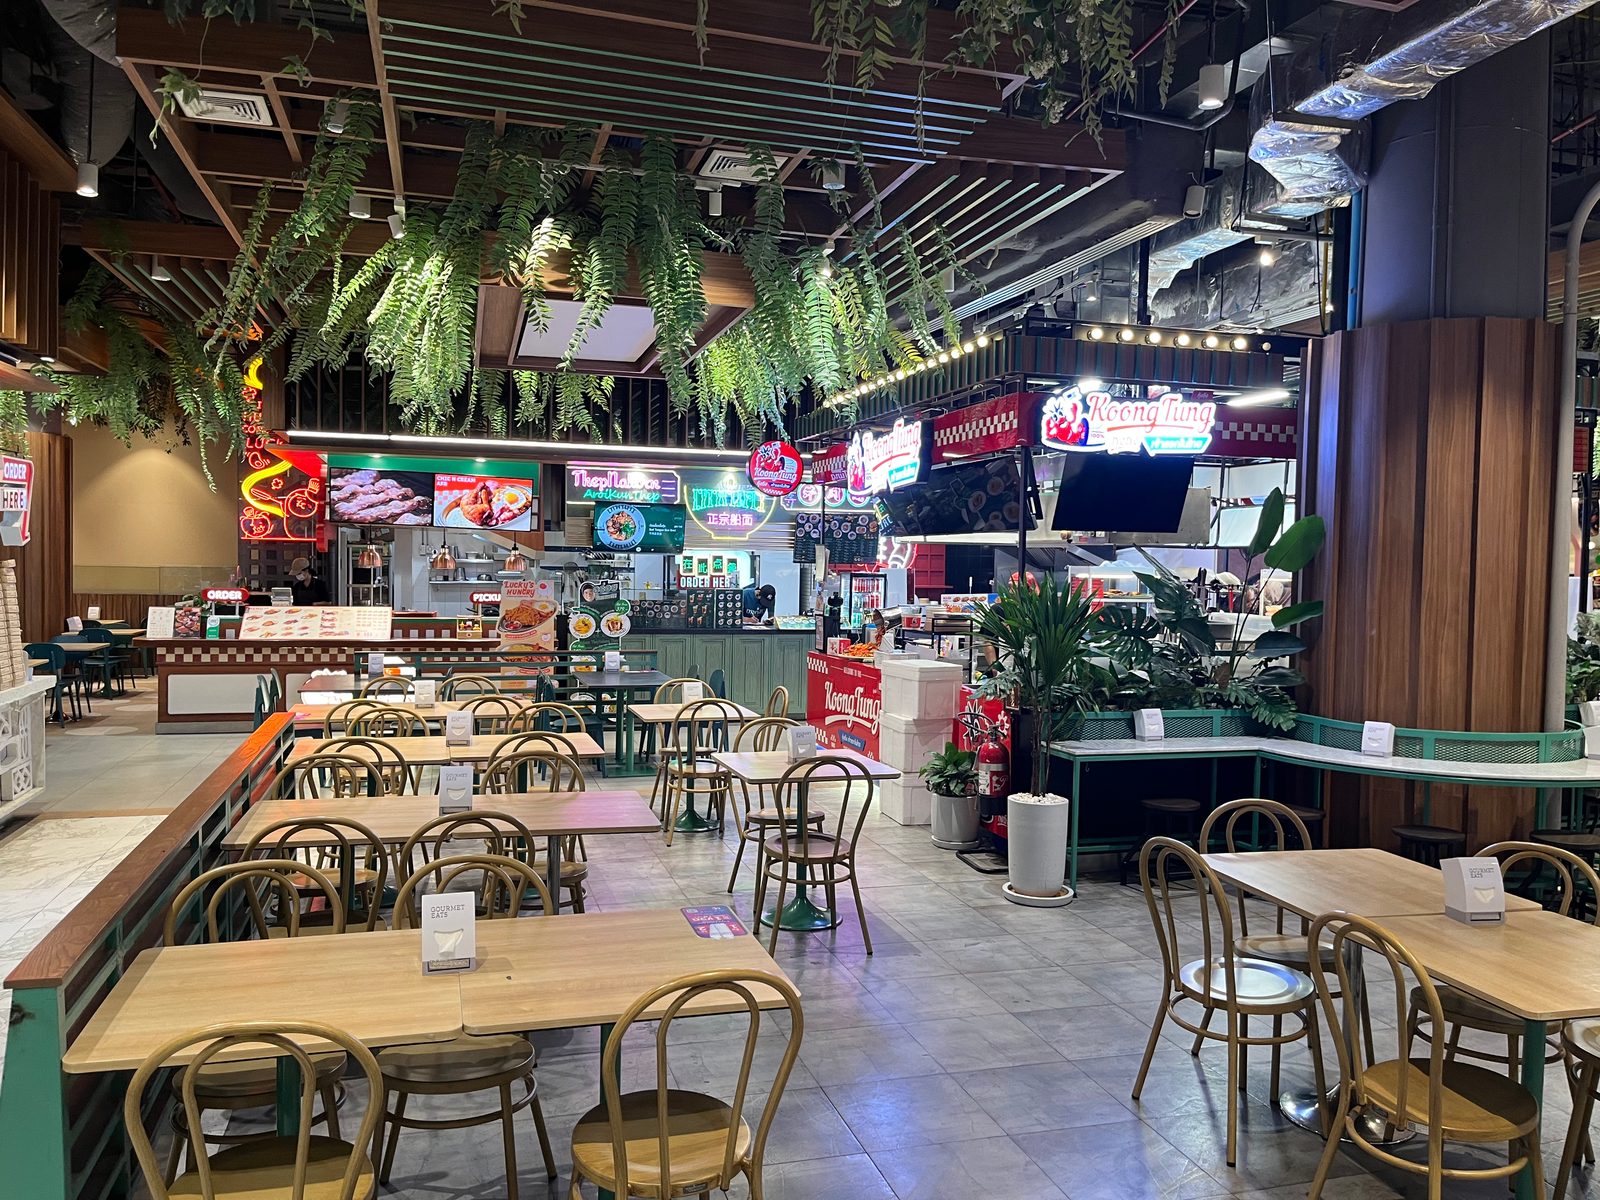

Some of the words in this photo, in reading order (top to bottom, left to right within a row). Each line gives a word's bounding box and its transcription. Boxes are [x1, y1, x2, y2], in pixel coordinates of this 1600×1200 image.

[4, 462, 27, 480] ORDER
[3, 491, 24, 509] HERE
[680, 577, 710, 588] ORDER
[712, 577, 731, 588] HER
[206, 590, 243, 600] ORDER
[473, 593, 501, 602] PICKU
[430, 904, 465, 913] GOURMET
[431, 911, 448, 919] EATS
